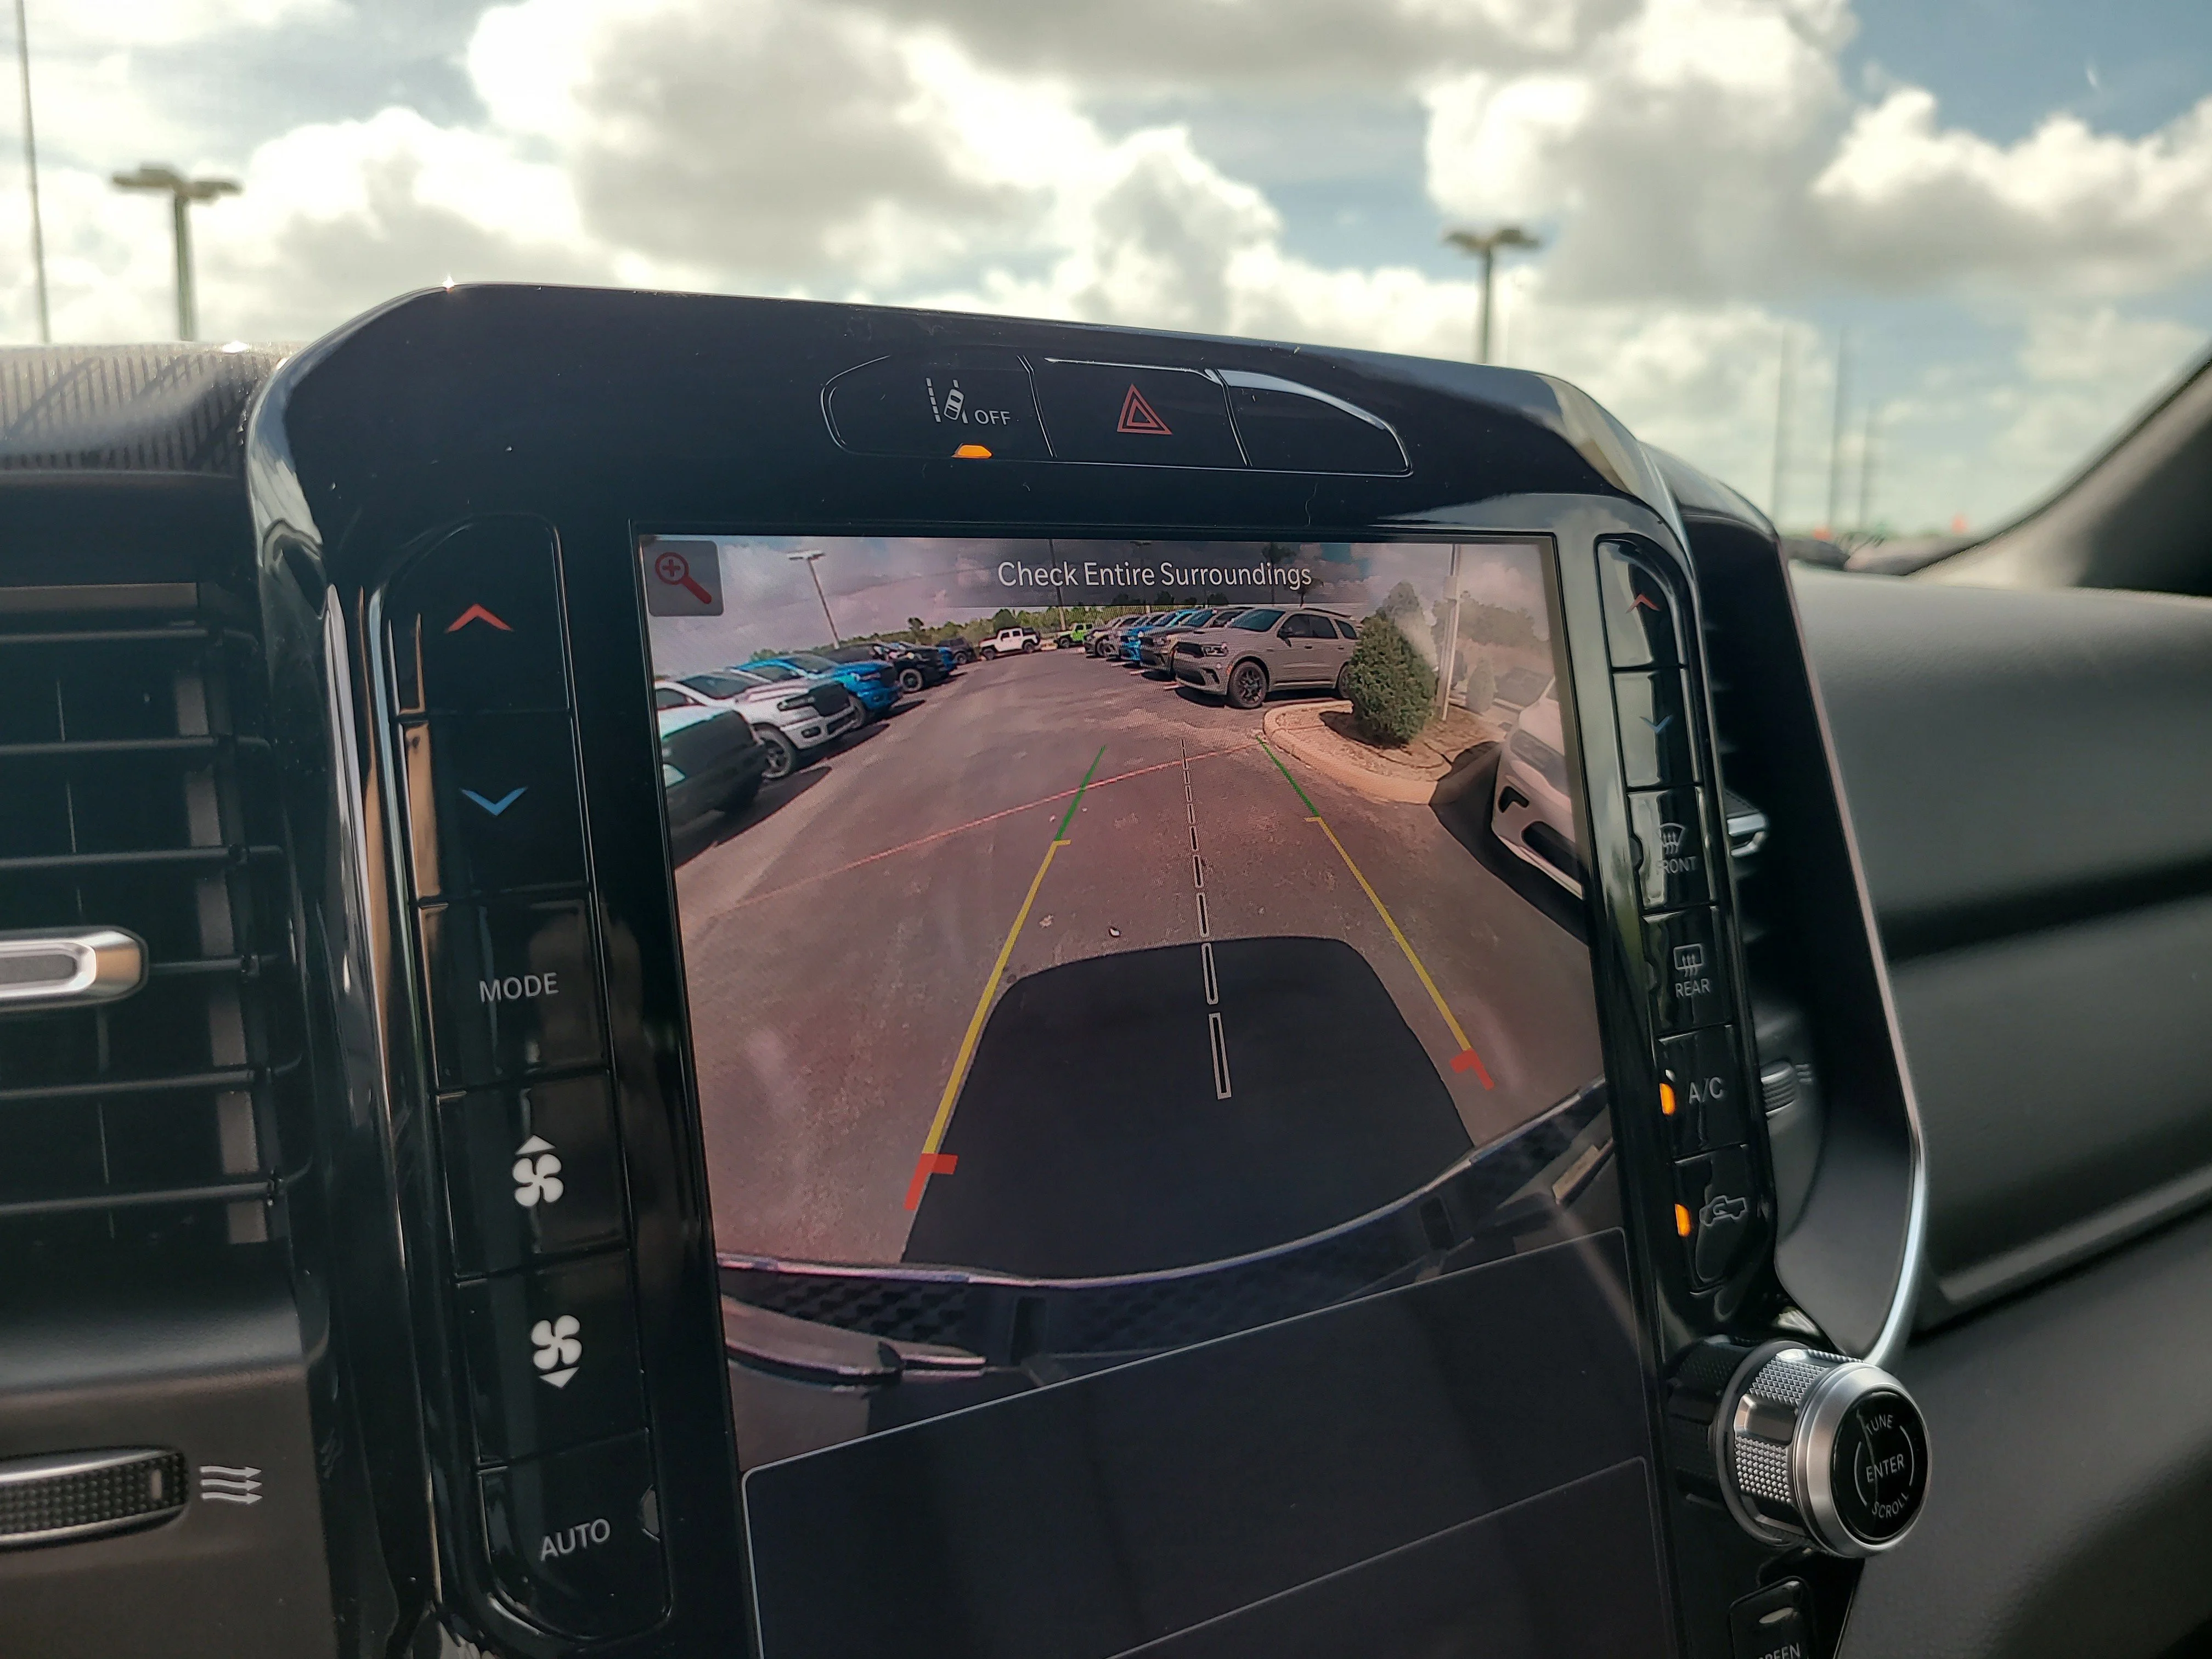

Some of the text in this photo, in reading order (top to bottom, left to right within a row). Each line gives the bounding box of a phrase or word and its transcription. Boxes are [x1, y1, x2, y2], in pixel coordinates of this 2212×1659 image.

[974, 409, 1011, 426] OFF
[998, 561, 1312, 591] Check Entire Surroundings
[478, 972, 560, 1003] MODE
[1675, 978, 1711, 998] REAR
[1689, 1076, 1725, 1104] A/C
[1864, 1414, 1894, 1435] TUNE
[1866, 1454, 1905, 1483] ENTER
[1872, 1492, 1910, 1519] SCROLL
[540, 1518, 611, 1561] AUTO
